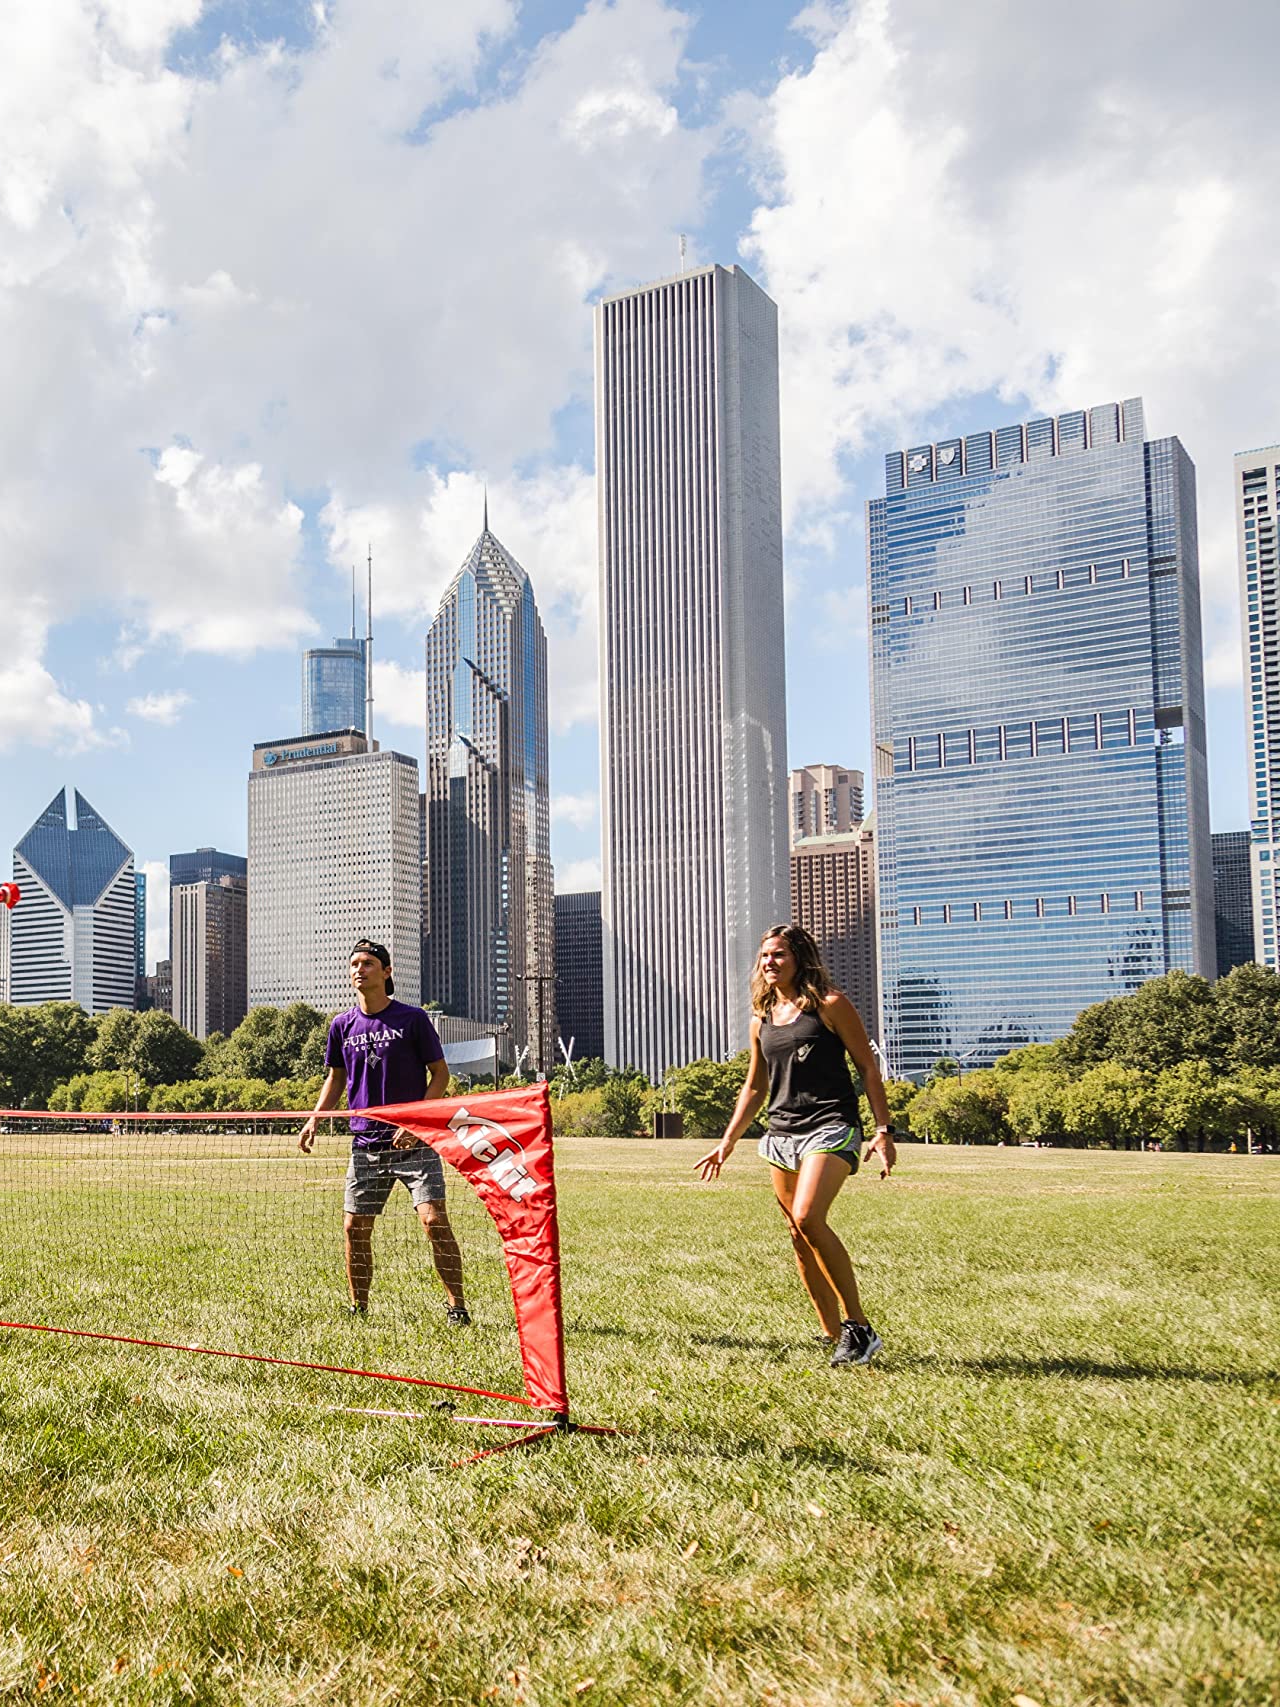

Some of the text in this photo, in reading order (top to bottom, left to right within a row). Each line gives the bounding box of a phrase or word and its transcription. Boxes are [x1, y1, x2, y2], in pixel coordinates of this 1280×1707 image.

[281, 742, 337, 760] Prudential
[343, 1028, 404, 1048] FURMAN
[355, 1041, 390, 1052] SOCCER
